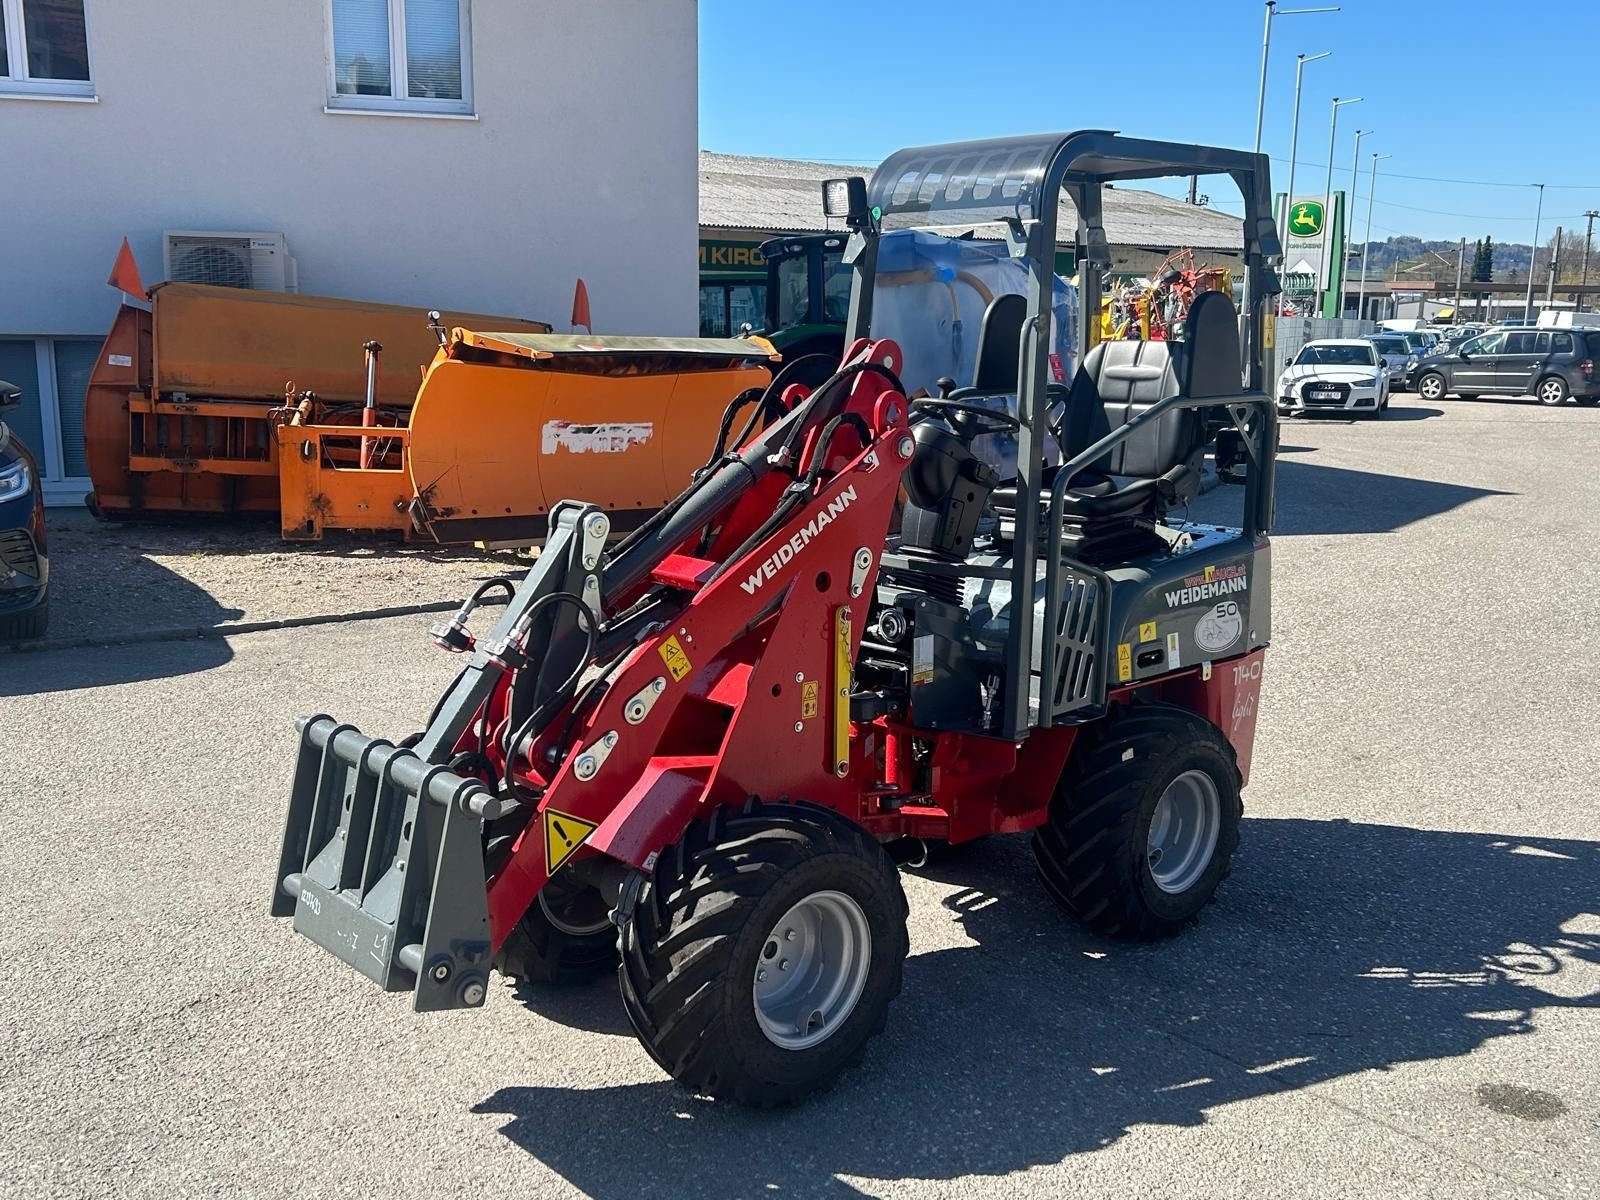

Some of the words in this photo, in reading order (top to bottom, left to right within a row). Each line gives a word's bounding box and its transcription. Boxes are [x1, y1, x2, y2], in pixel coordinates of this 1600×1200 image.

[711, 247, 768, 266] KIRC
[740, 484, 858, 595] WEIDEMANN
[1164, 575, 1247, 608] WEIDEMANN
[1217, 602, 1237, 618] 50
